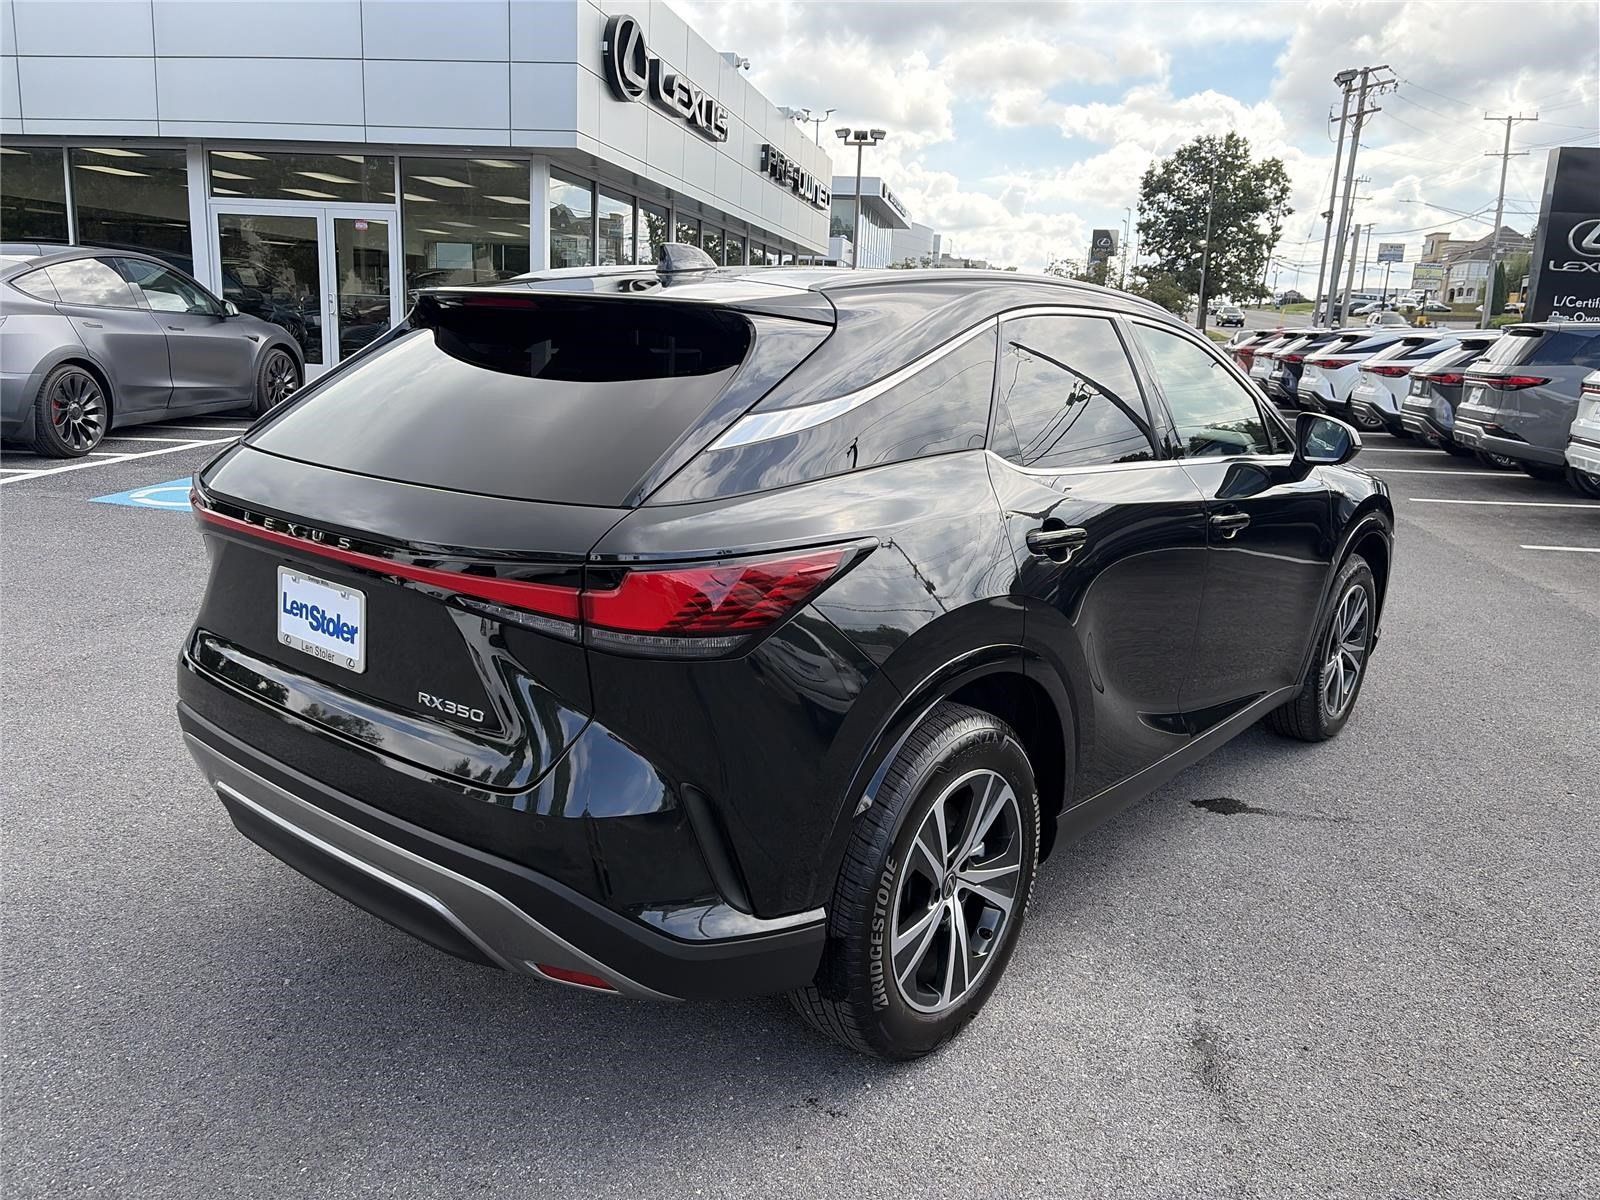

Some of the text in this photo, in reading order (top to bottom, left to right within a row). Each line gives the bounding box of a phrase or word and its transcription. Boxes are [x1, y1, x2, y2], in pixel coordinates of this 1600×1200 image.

[649, 58, 729, 142] LEXUS
[761, 144, 831, 210] PRE-OWNED
[1549, 260, 1600, 273] LEX
[243, 511, 352, 549] LEXUS
[301, 640, 335, 662] Len Stoler
[417, 691, 486, 724] RX350
[869, 855, 898, 1012] BRIDGESTONE
